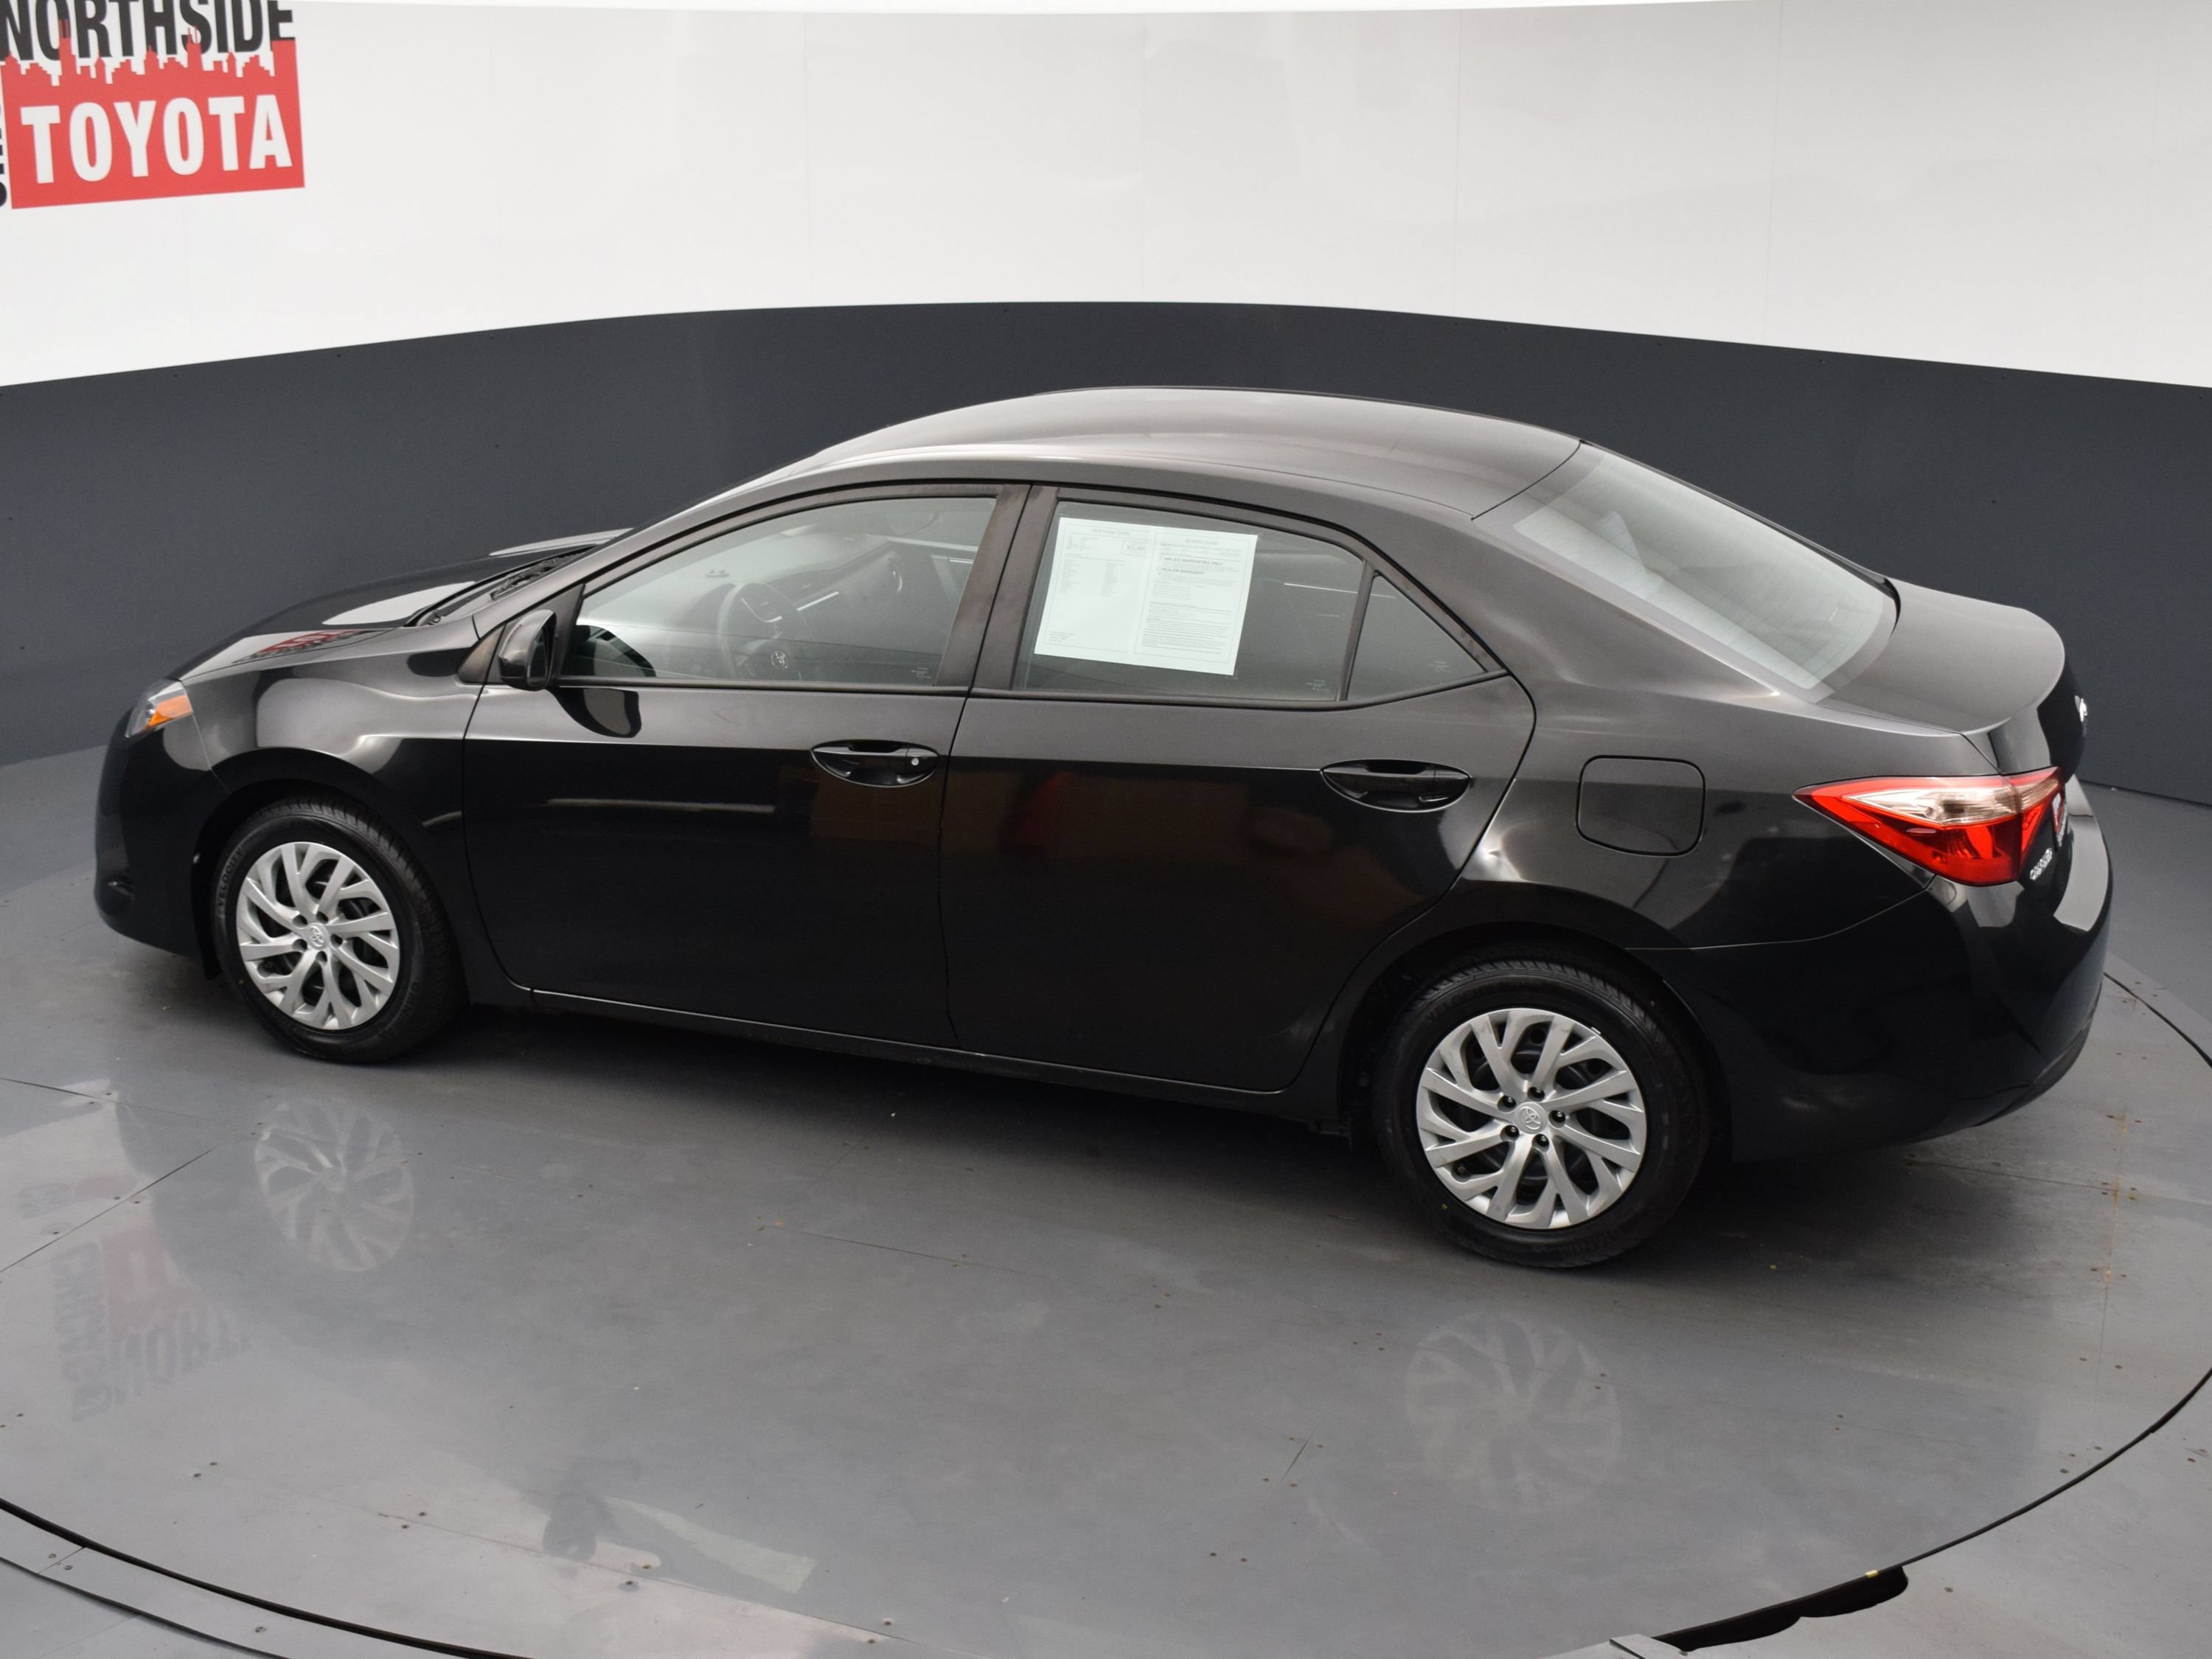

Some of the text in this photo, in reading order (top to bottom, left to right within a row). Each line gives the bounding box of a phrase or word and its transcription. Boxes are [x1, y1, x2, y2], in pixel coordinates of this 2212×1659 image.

[0, 0, 294, 61] NORTHSIDE
[21, 94, 293, 184] TOYOTA
[217, 846, 244, 906] VELOCITY
